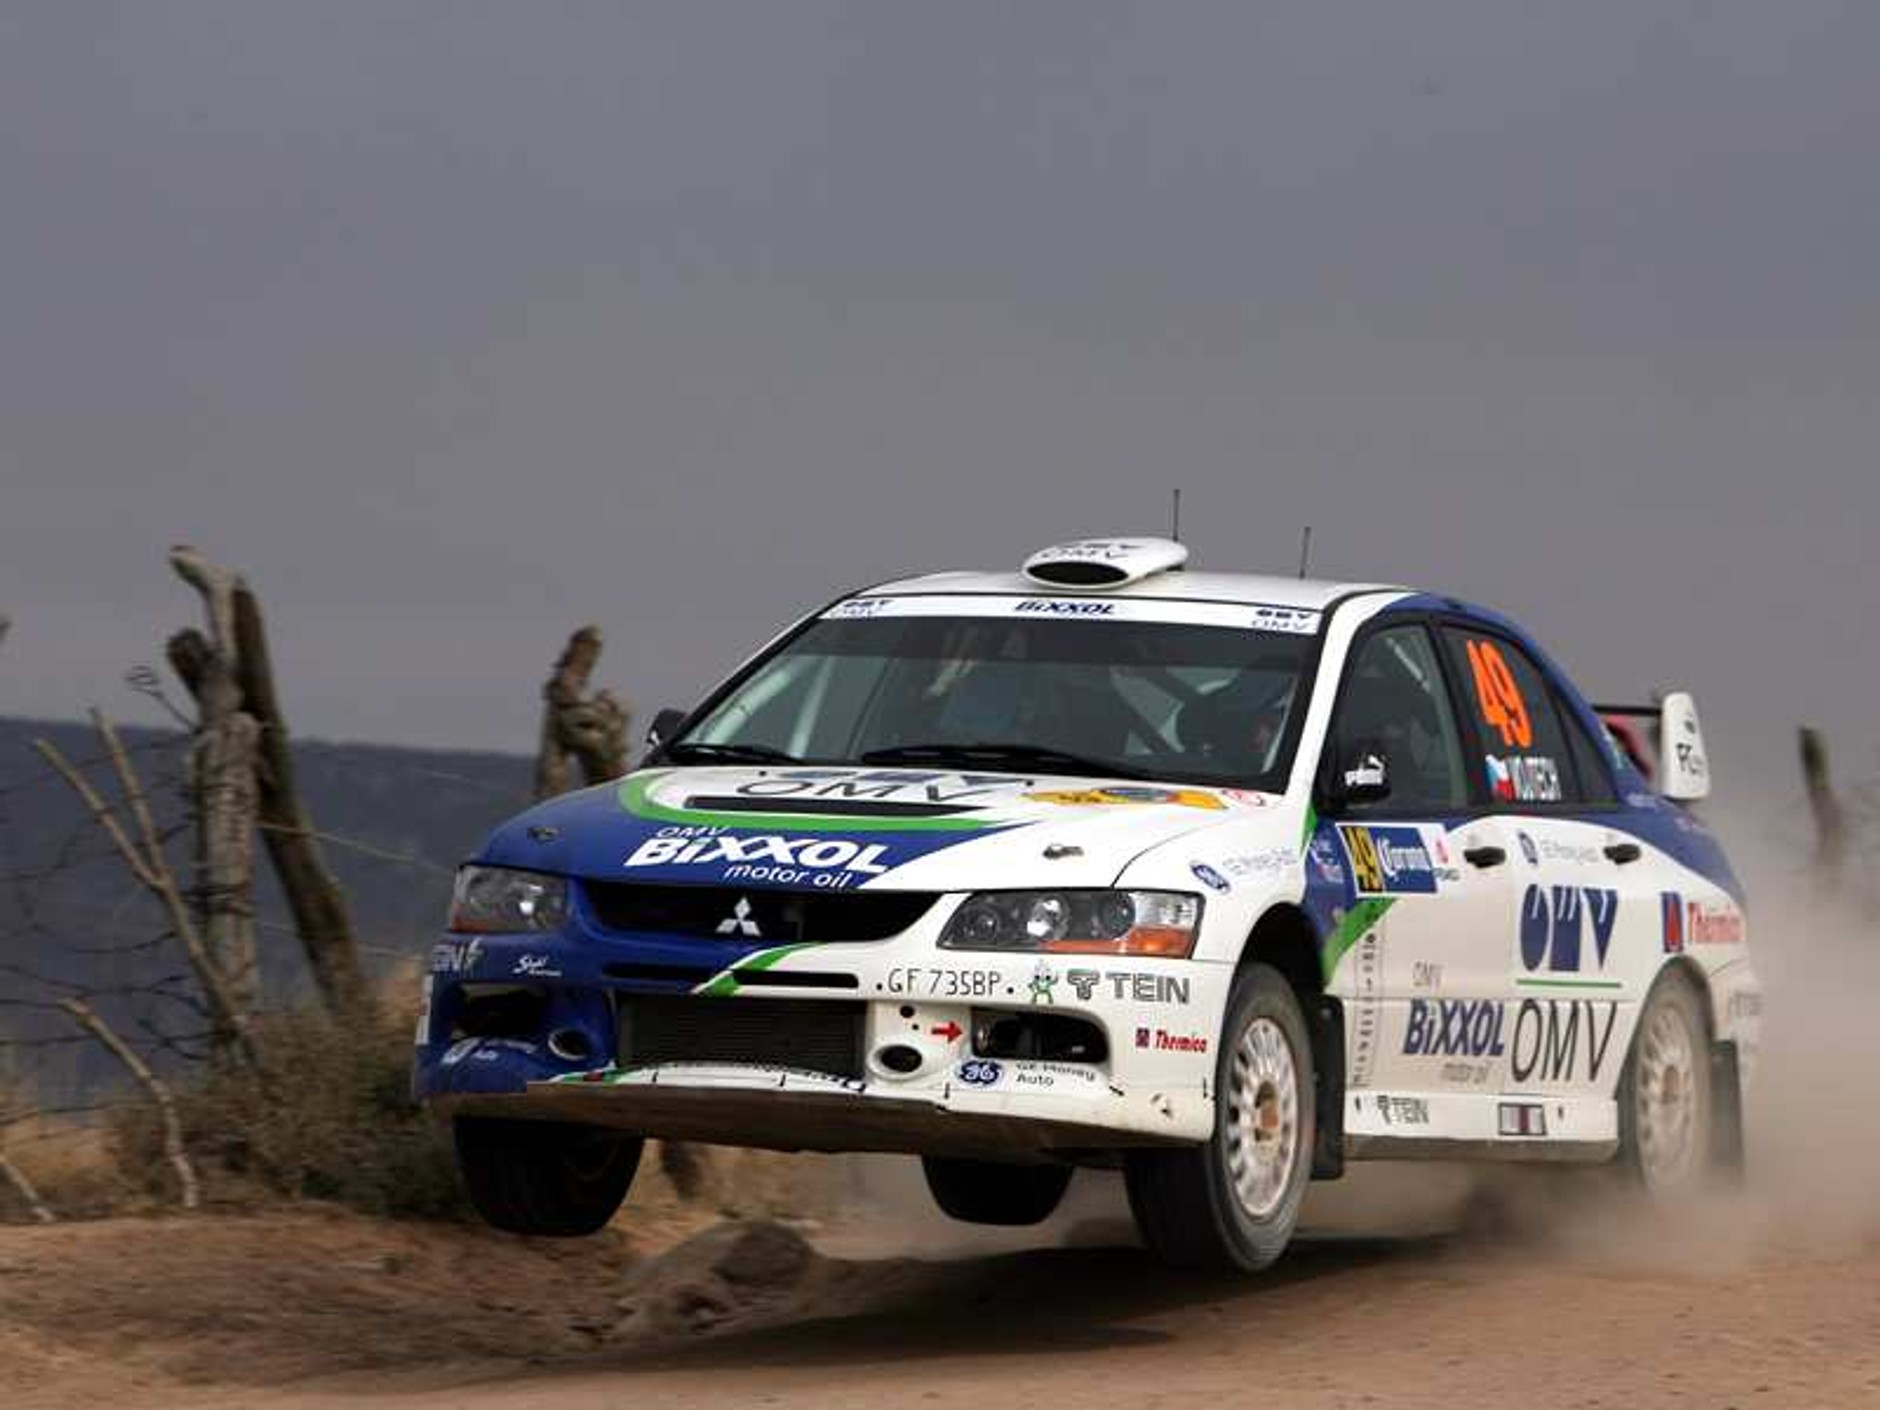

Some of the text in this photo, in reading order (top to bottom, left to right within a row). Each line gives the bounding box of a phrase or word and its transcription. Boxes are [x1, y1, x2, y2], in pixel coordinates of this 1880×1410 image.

[1466, 638, 1531, 748] 49
[623, 836, 889, 873] BiXXOL
[723, 864, 853, 889] motor oil
[887, 968, 921, 994] GF
[1105, 973, 1191, 1005] TEIN
[1402, 999, 1505, 1057] BiXXOL
[1510, 999, 1618, 1083] OMV
